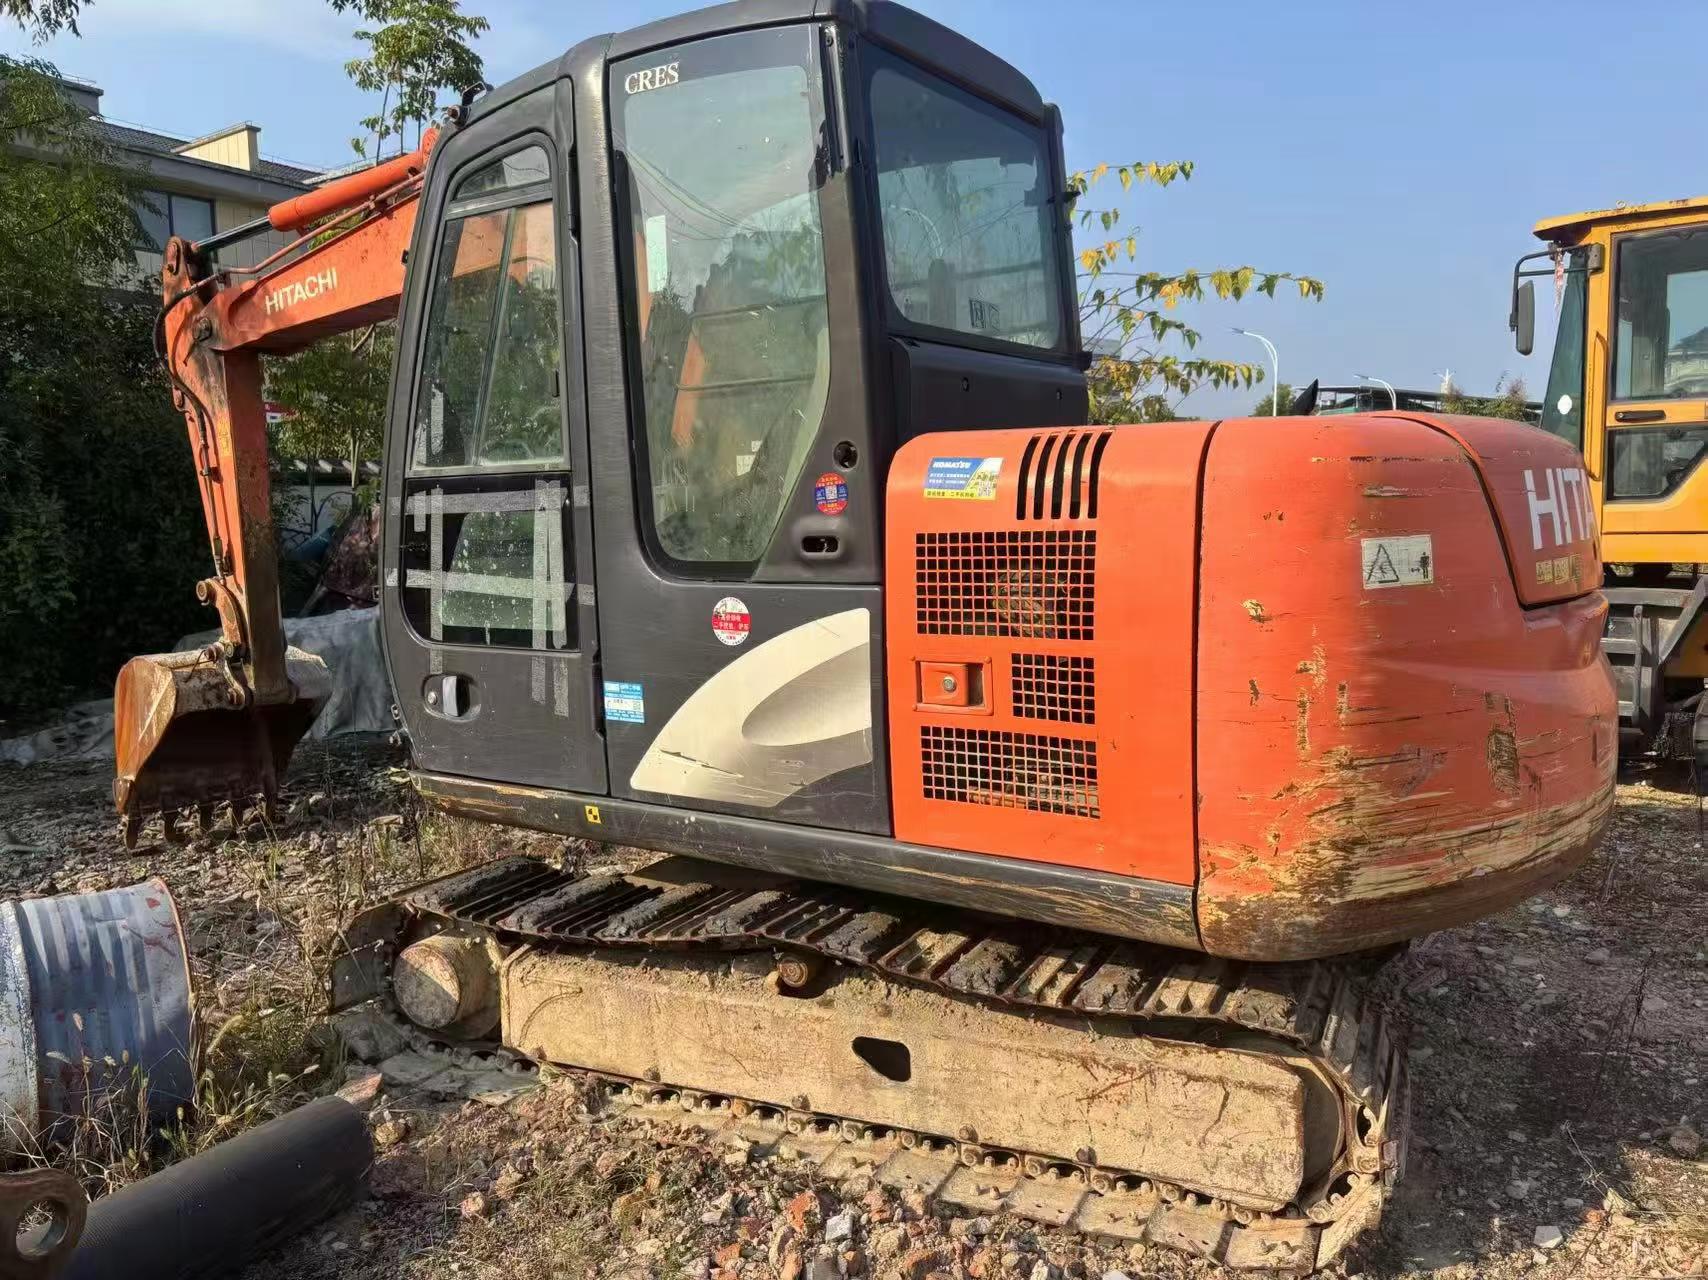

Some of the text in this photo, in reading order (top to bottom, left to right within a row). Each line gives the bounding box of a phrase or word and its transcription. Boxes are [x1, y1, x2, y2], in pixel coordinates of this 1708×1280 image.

[625, 62, 679, 94] CRES
[265, 267, 337, 315] HITACHI
[932, 461, 972, 469] KOMATSU
